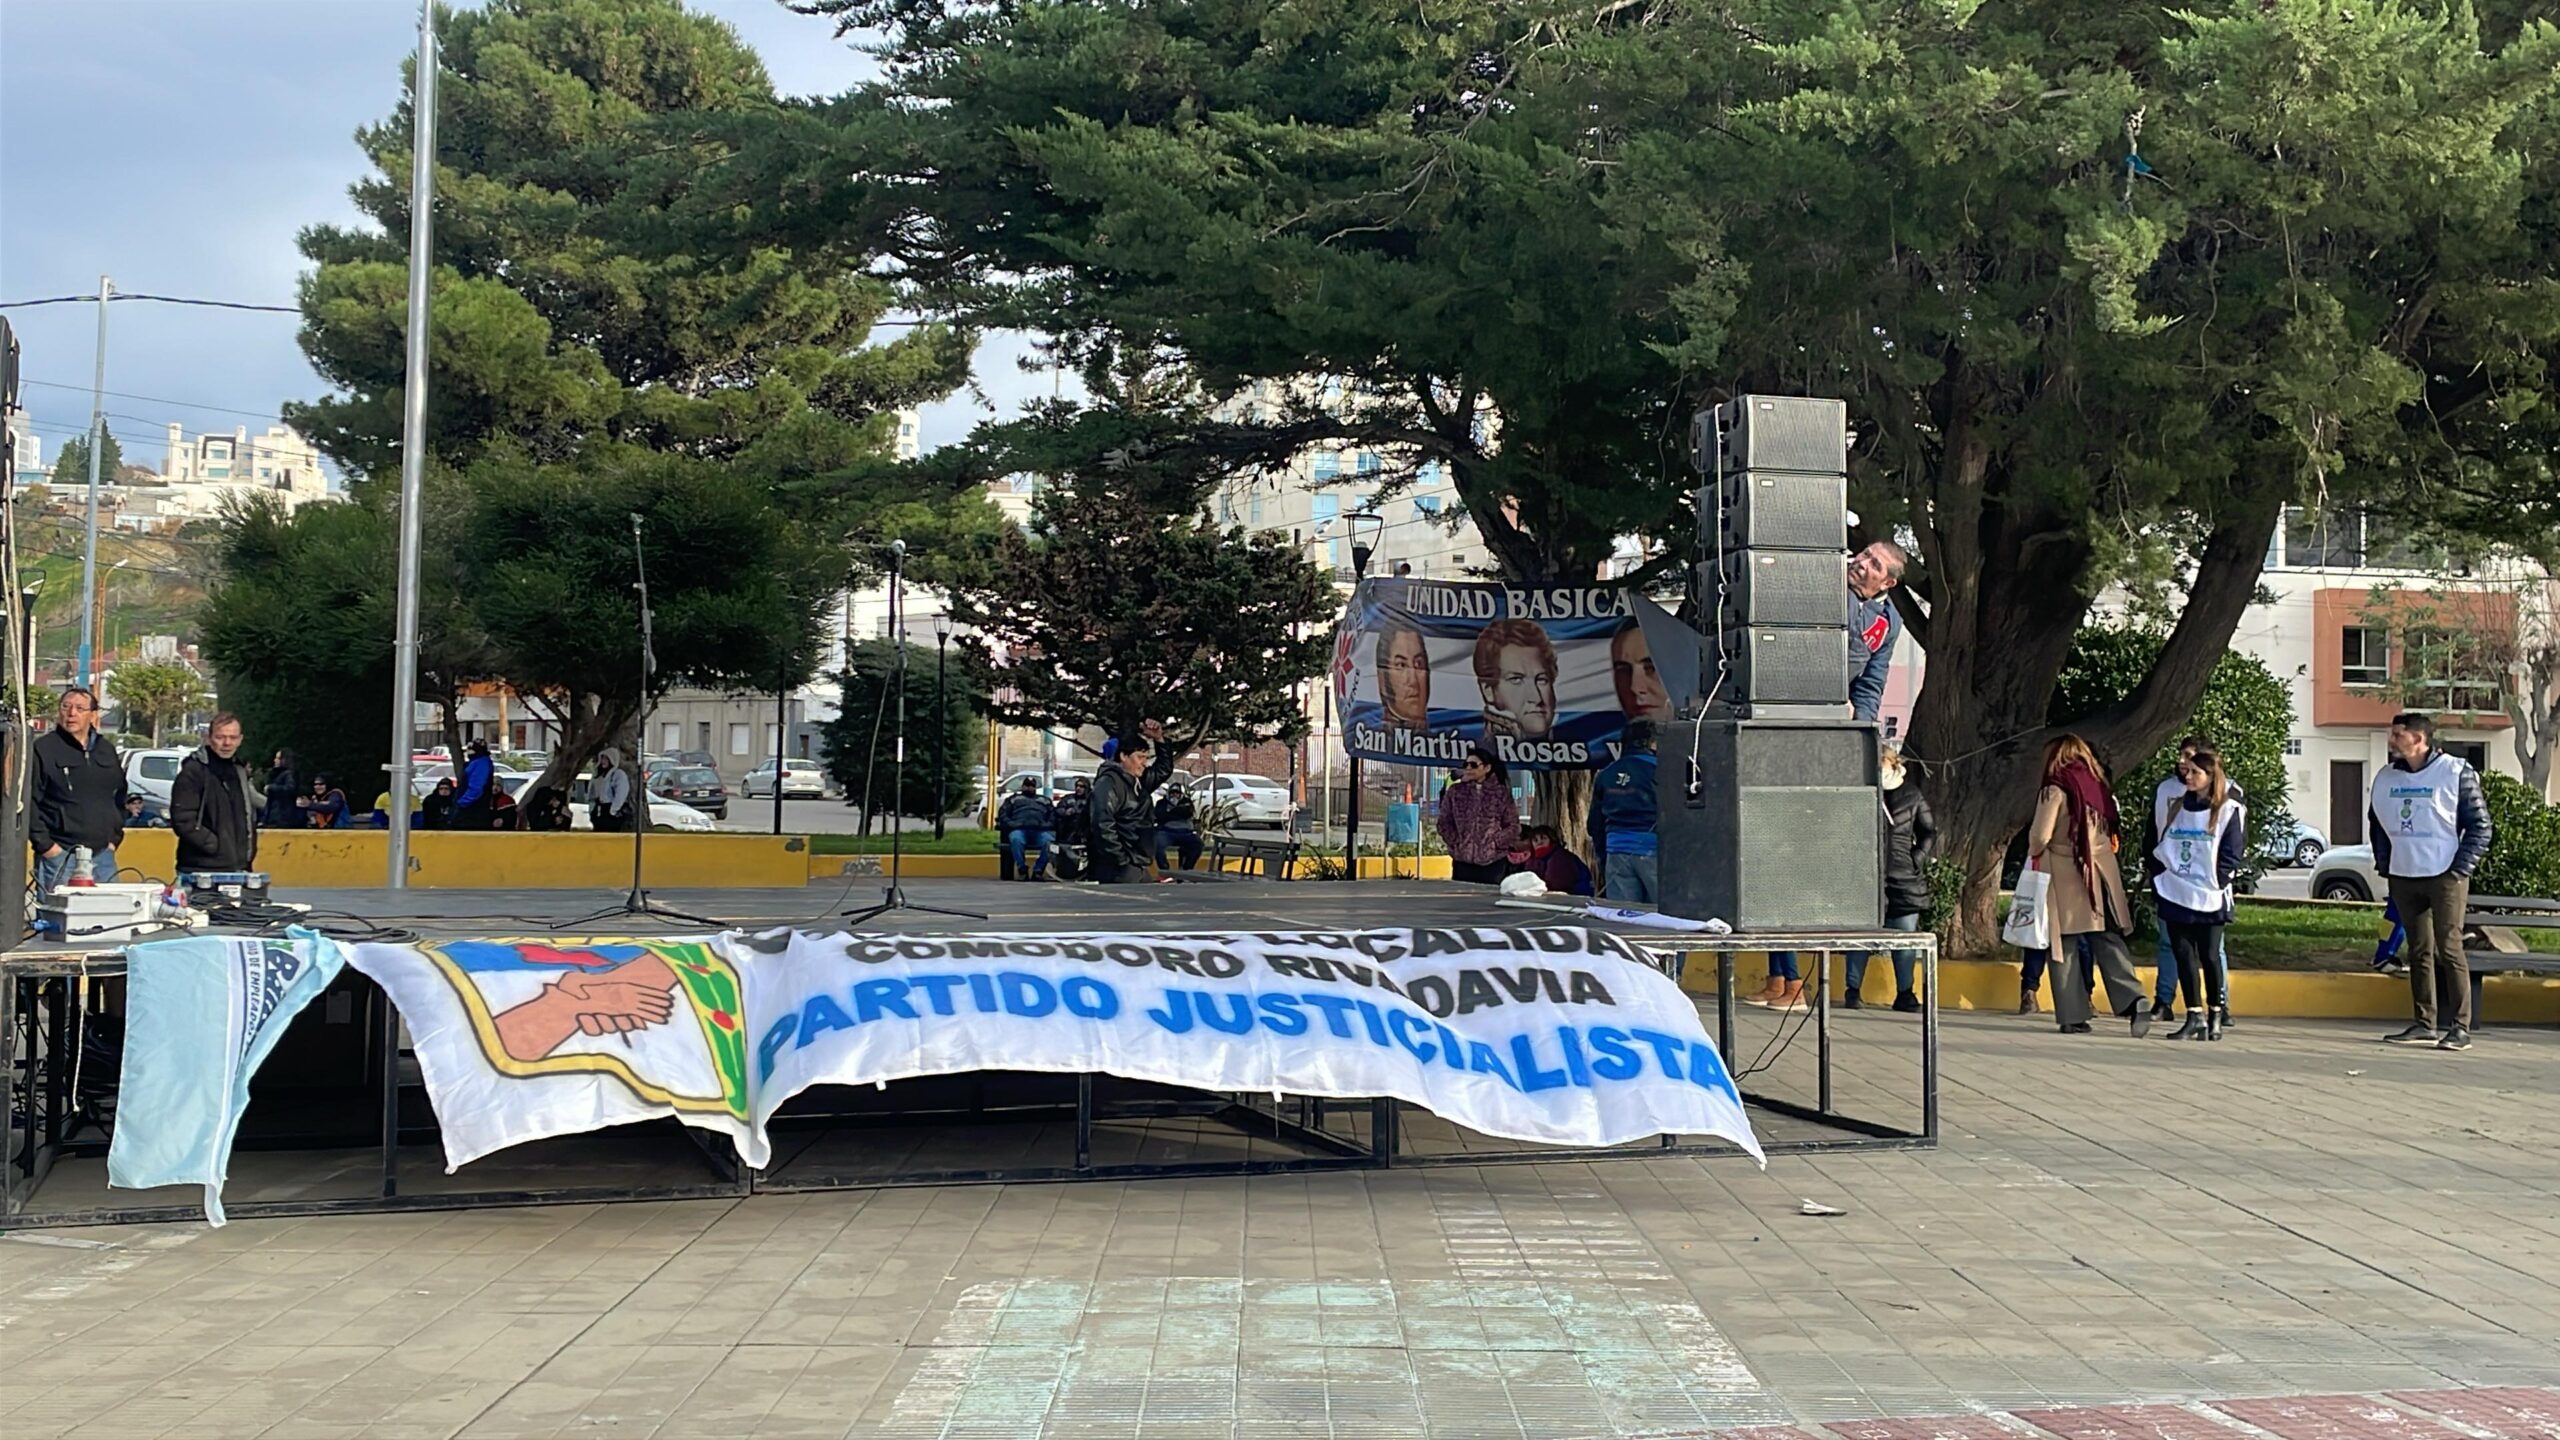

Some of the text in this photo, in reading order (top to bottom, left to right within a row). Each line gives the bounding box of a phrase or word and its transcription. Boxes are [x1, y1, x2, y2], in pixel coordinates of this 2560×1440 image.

[1406, 585, 1634, 620] UNIDAD BASICA
[1354, 722, 1386, 753] San
[1496, 736, 1589, 763] Rosas
[845, 940, 1246, 979] COMODORO
[758, 971, 1119, 1085] PARTIDO
[1147, 988, 1738, 1103] JUSTICIALISTA
